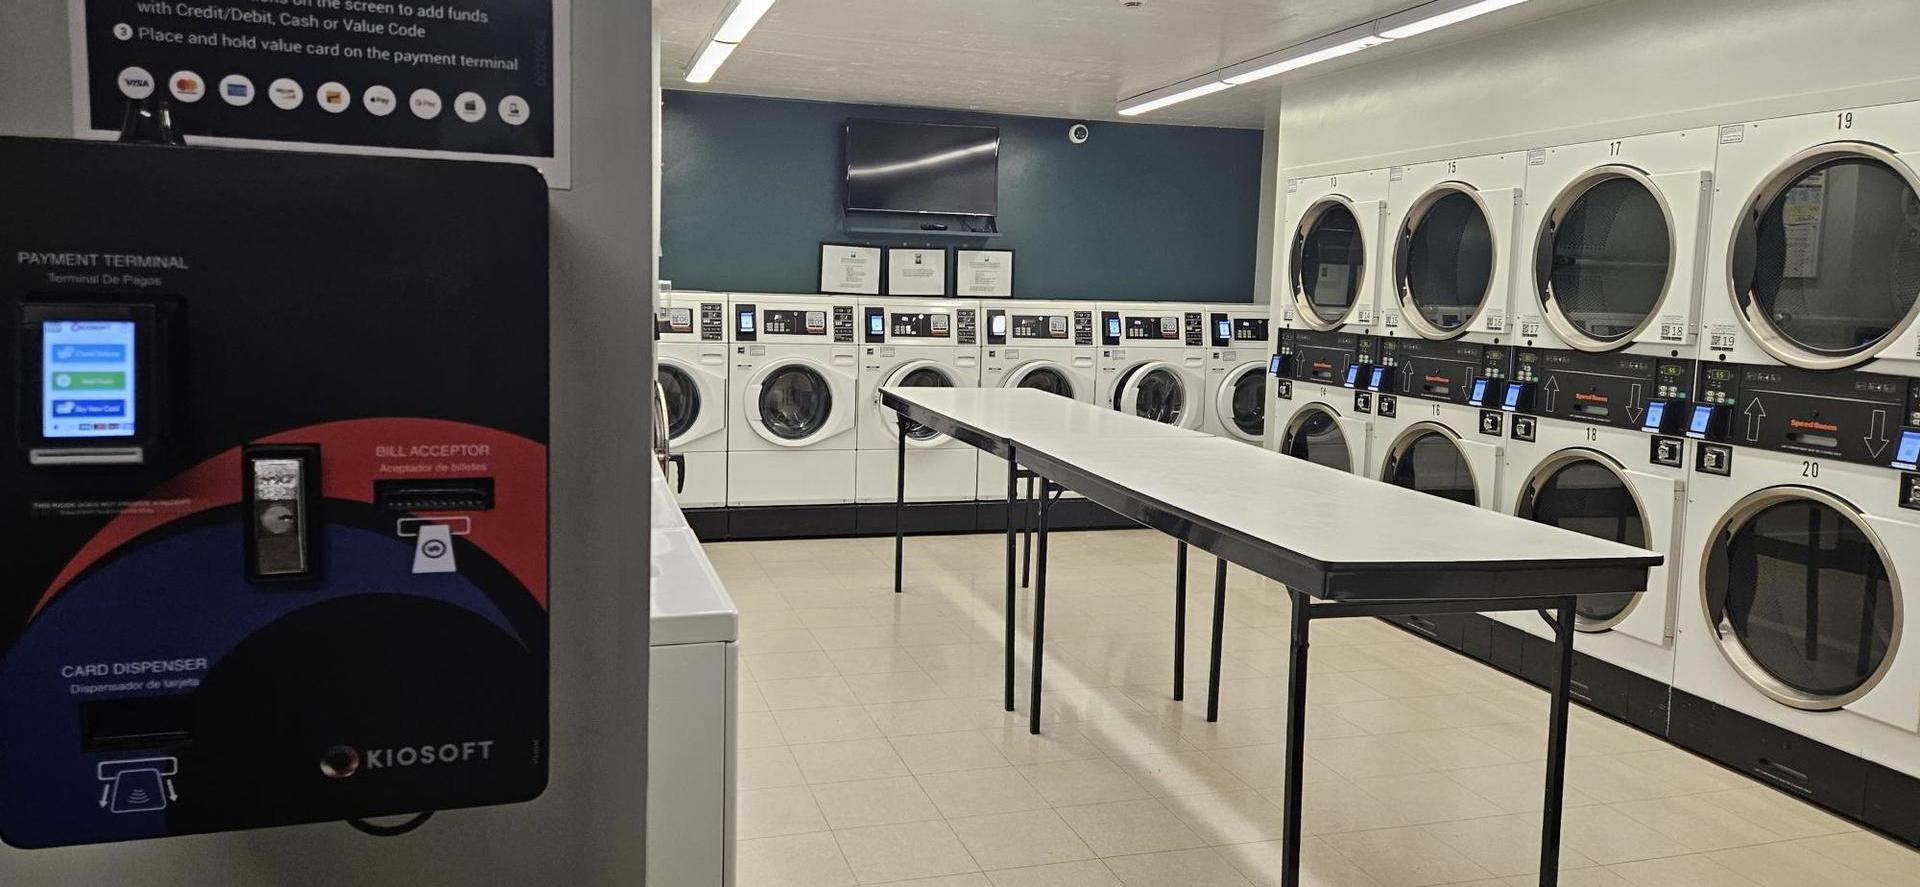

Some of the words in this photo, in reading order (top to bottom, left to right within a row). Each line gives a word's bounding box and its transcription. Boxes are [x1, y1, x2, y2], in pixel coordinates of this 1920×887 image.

[137, 2, 171, 15] with
[176, 4, 276, 25] Credit/Debit,
[280, 13, 318, 28] Cash
[323, 19, 339, 30] or
[343, 19, 384, 34] Value
[388, 23, 426, 37] Code
[345, 1, 394, 15] screen
[399, 4, 413, 16] to
[417, 6, 444, 19] add
[449, 8, 488, 24] funds
[139, 27, 183, 42] Place
[188, 32, 217, 46] and
[222, 33, 256, 49] hold
[261, 38, 302, 53] value
[306, 43, 339, 56] card
[344, 47, 362, 58] on
[367, 46, 390, 61] the
[394, 51, 456, 66] payment
[461, 55, 518, 71] terminal
[124, 78, 149, 88] VISA
[1837, 112, 1853, 130] 19
[1610, 141, 1621, 156] 17
[1448, 161, 1456, 174] 15
[18, 252, 99, 266] PAYMENT
[104, 254, 189, 269] TERMINAL
[48, 273, 99, 284] Terminal
[103, 274, 121, 285] De
[124, 275, 161, 287] Pagos
[1530, 325, 1539, 333] 17
[1672, 326, 1683, 336] 18
[1723, 336, 1735, 347] 19
[1432, 404, 1441, 415] 16
[1586, 427, 1597, 441] 18
[376, 446, 406, 458] BILL
[409, 445, 490, 457] ACCEPTOR
[379, 463, 432, 474] Aceptador
[435, 463, 448, 472] de
[451, 462, 487, 472] billetes
[1802, 461, 1819, 478] 20
[61, 664, 109, 678] CARD
[113, 658, 208, 675] DISPENSER
[70, 682, 143, 694] Dispensador
[146, 680, 160, 689] de
[164, 678, 200, 689] tarjeta
[366, 740, 495, 769] KIOSOFT
